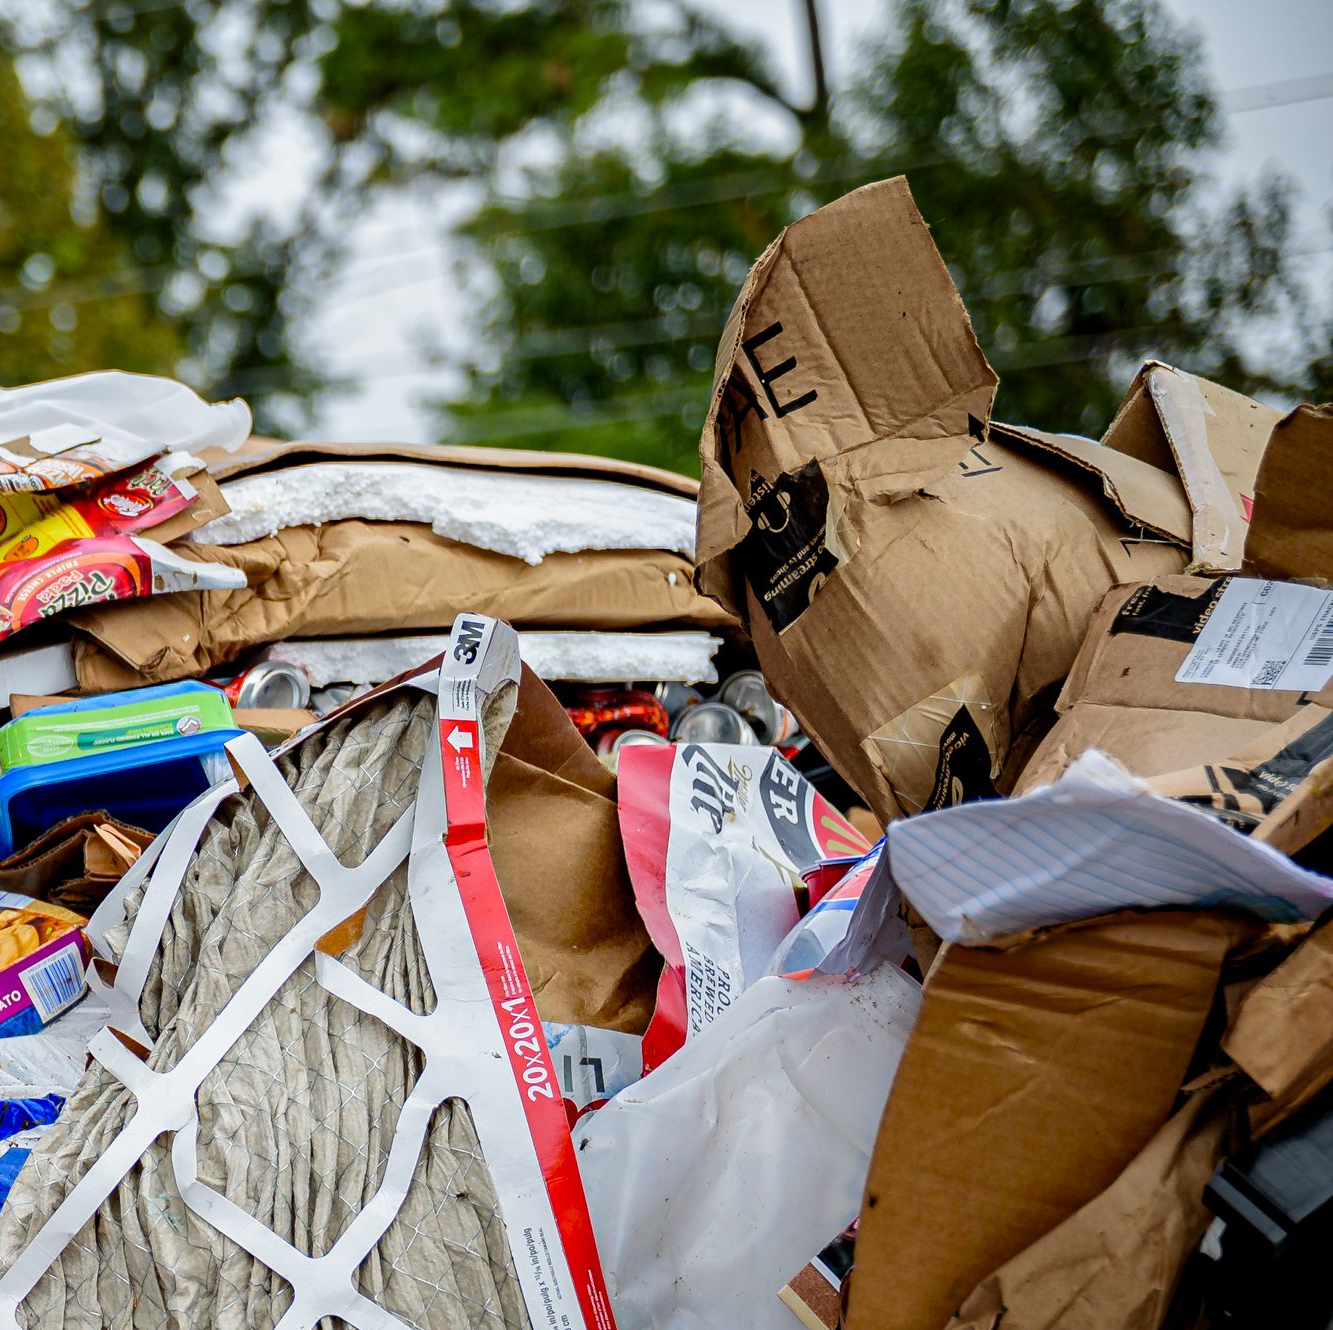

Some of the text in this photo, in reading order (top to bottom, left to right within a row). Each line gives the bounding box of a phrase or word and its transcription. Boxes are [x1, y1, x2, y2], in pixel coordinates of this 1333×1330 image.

[796, 545, 811, 559] and
[17, 559, 79, 602] TRIPLE CHEESE
[762, 553, 820, 603] streaming
[1192, 601, 1217, 635] video
[453, 620, 485, 665] 3M
[702, 955, 715, 1024] BREWED
[500, 996, 555, 1102] 20x20x1
